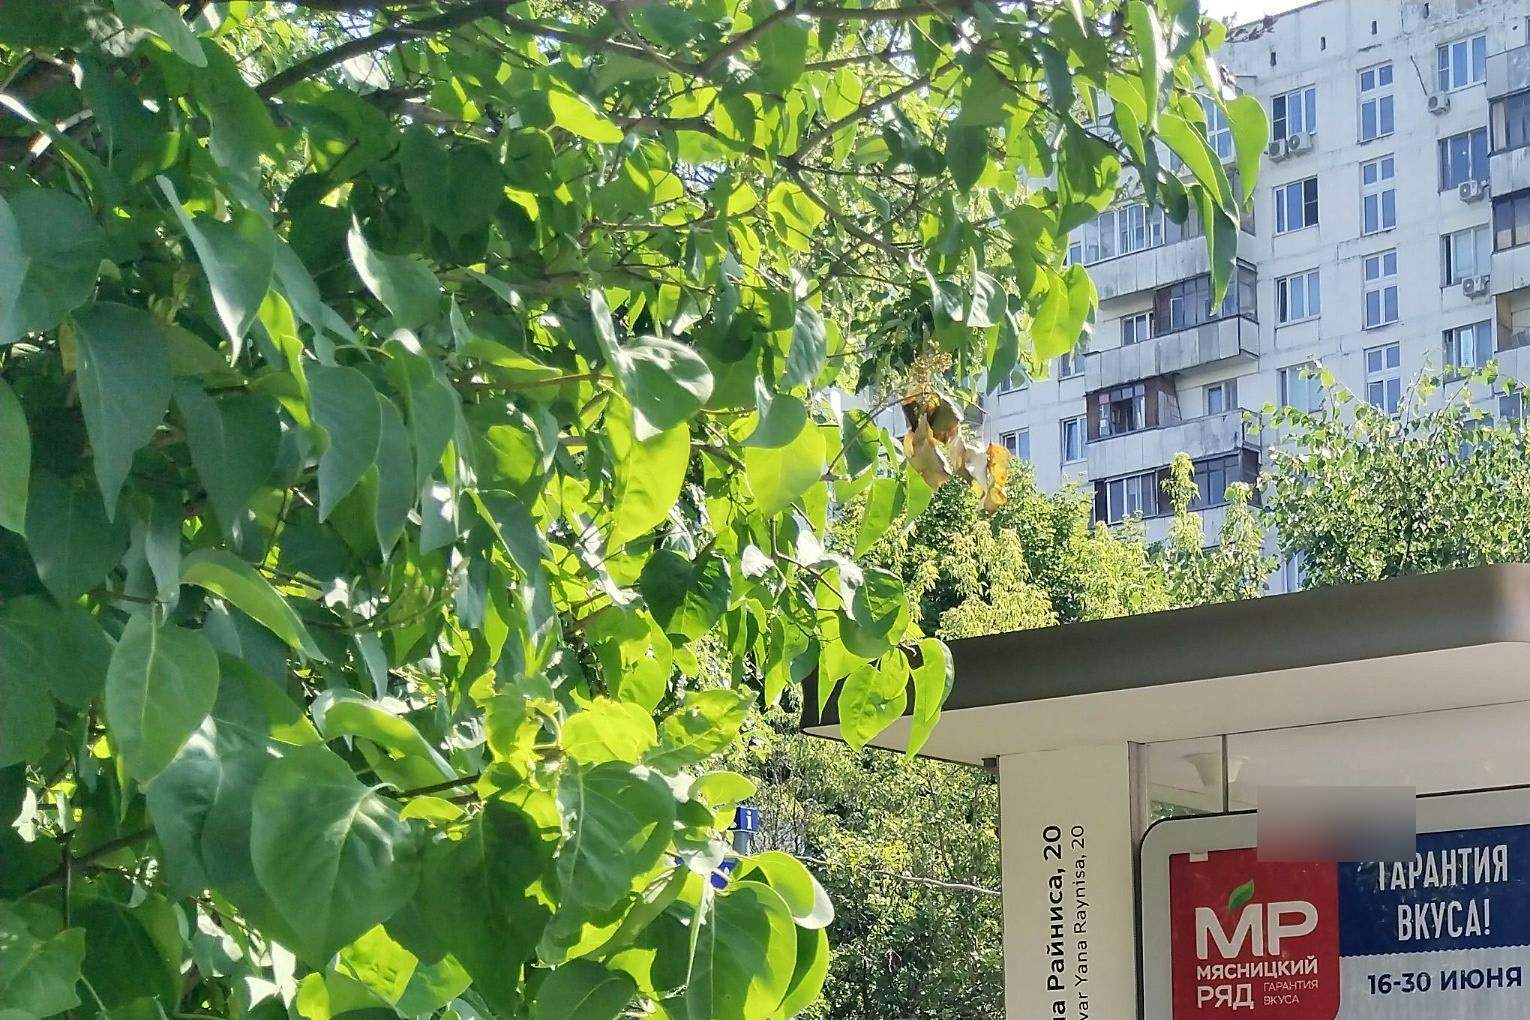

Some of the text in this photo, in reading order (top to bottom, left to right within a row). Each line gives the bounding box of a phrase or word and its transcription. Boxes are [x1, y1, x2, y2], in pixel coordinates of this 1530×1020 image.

[1043, 825, 1062, 860] 20
[1071, 825, 1085, 849] 20
[1379, 844, 1508, 891] ГАРАНТИЯ
[1072, 854, 1090, 934] Raynisa,
[1046, 868, 1067, 991] Райниса,
[1398, 899, 1491, 941] ВКУСА!
[1074, 940, 1088, 987] Yana
[1196, 955, 1318, 980] МЯСНИЦКИЙ
[1263, 979, 1319, 992] ГАРАНТИЯ
[1368, 966, 1523, 995] 16-30 ИЮНЯ
[1197, 983, 1255, 1011] РЯД
[1263, 994, 1300, 1006] ВКУСА
